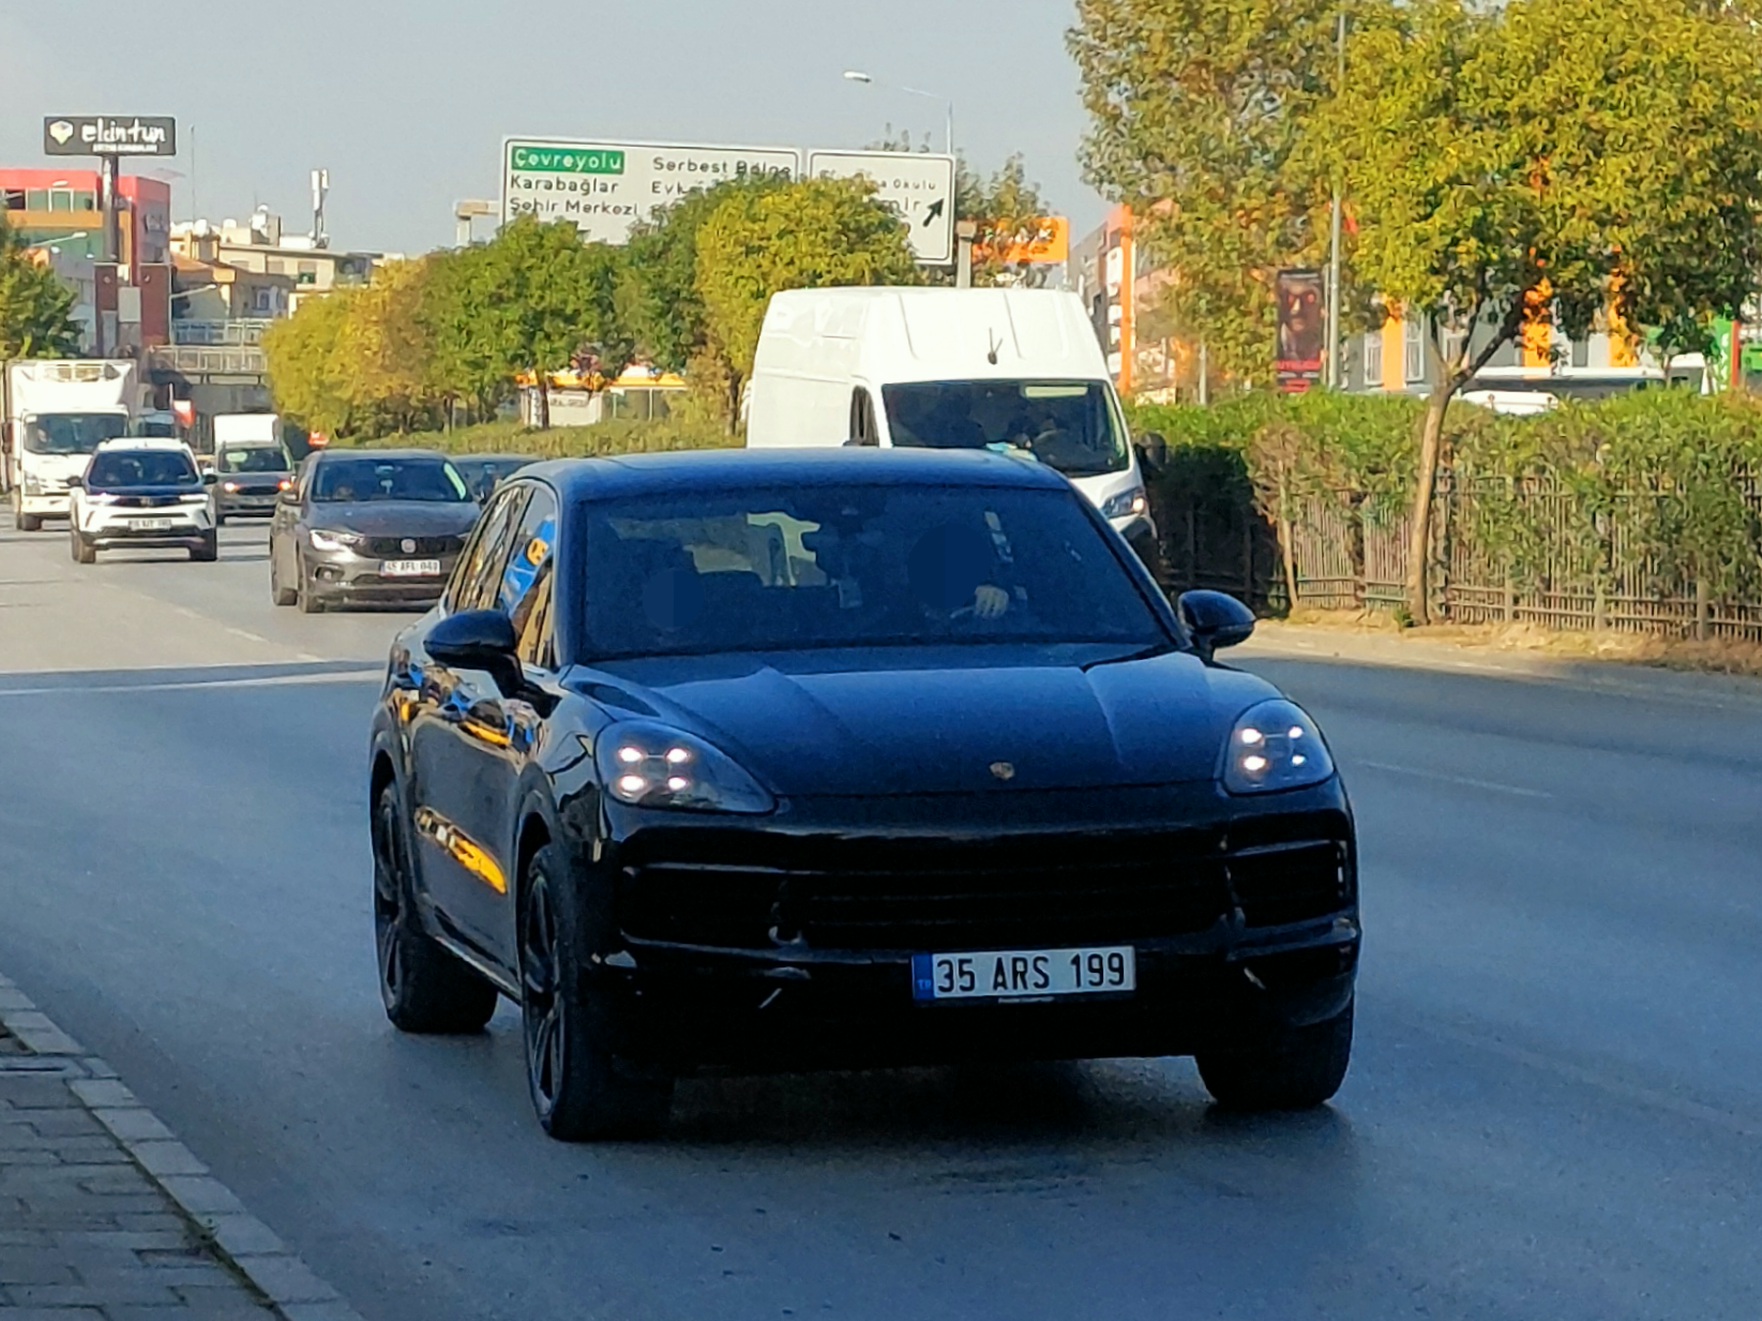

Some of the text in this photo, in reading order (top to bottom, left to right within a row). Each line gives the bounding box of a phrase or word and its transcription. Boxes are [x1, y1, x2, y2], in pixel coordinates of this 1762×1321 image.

[514, 149, 622, 171] Çevreyolu
[653, 157, 728, 173] Serbest
[510, 175, 619, 196] Karabağlar
[509, 197, 640, 216] Şehir Merkezi
[937, 952, 1125, 993] 35 ARS 199
